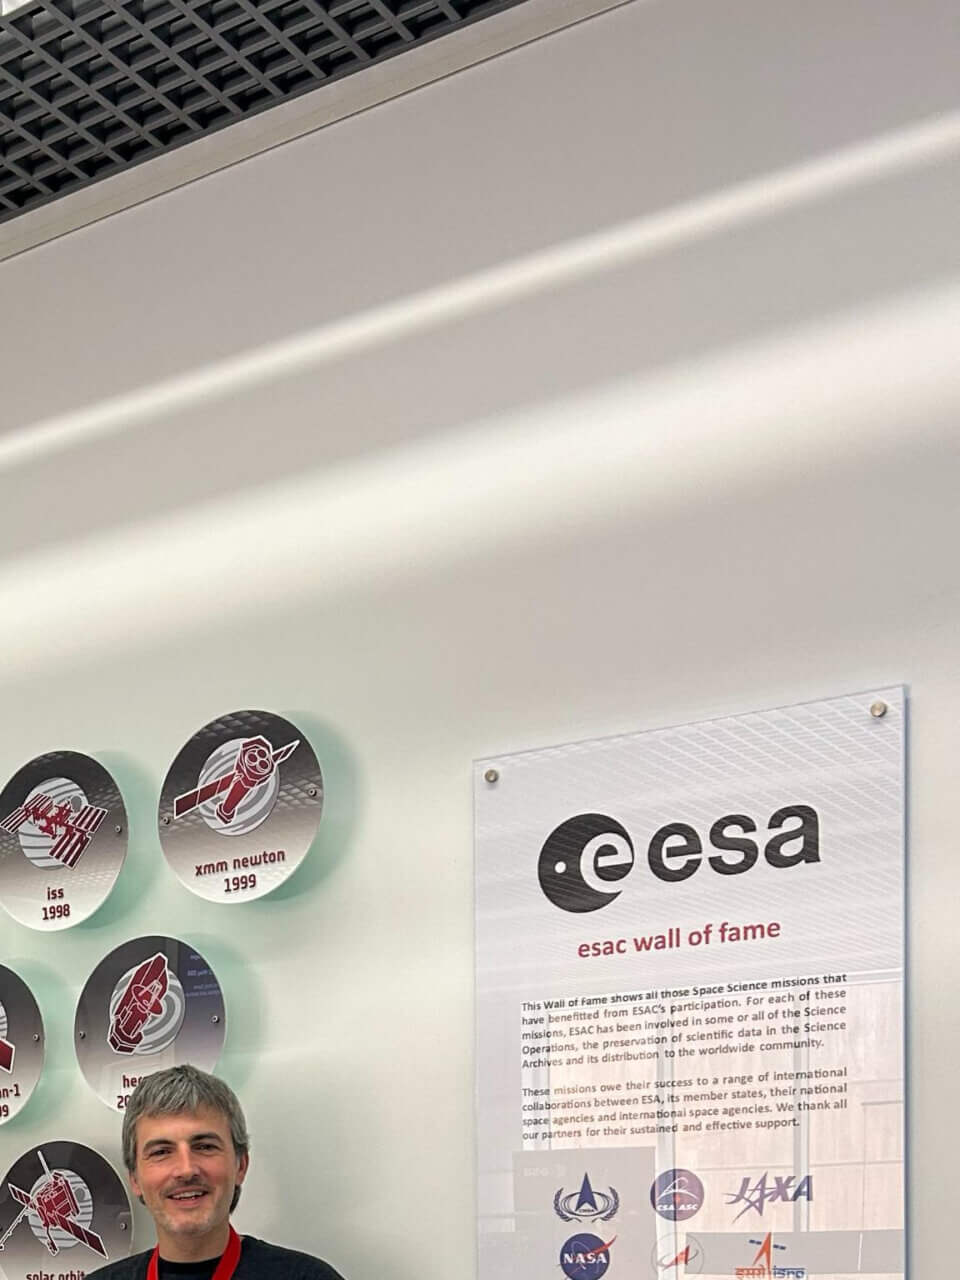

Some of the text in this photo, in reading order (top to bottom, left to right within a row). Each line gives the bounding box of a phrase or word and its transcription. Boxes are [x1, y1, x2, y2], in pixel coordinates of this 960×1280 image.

[647, 804, 821, 882] esa
[195, 850, 285, 877] xmm newton
[46, 886, 64, 900] iss
[224, 874, 256, 893] 1999
[42, 904, 71, 921] 1998
[577, 919, 781, 958] esac wall of fame
[521, 973, 847, 1012] This Wall Fame shows those Space Science missions that
[521, 1016, 545, 1025] have
[548, 1009, 600, 1024] benefitted
[603, 1008, 628, 1018] from
[670, 998, 742, 1015] participation.
[746, 996, 765, 1006] For
[768, 993, 795, 1005] each
[814, 989, 847, 1000] these
[521, 1005, 847, 1041] missions, ESAC has been involved some all the Science
[521, 1021, 847, 1056] Operations, the preservation scientific data the Science
[521, 1038, 825, 1069] Archives and distribution the worldwide community.
[521, 1067, 848, 1097] These missions owe their success range international
[521, 1083, 848, 1112] collaborations between ESA, member states, their national
[521, 1099, 848, 1128] space agencies and international space agencies. We thank all
[521, 1117, 800, 1142] our partners for their sustained and effective support.
[657, 1203, 698, 1211] CSA ASC
[726, 1171, 814, 1214] JAXA
[563, 1253, 607, 1264] NASA
